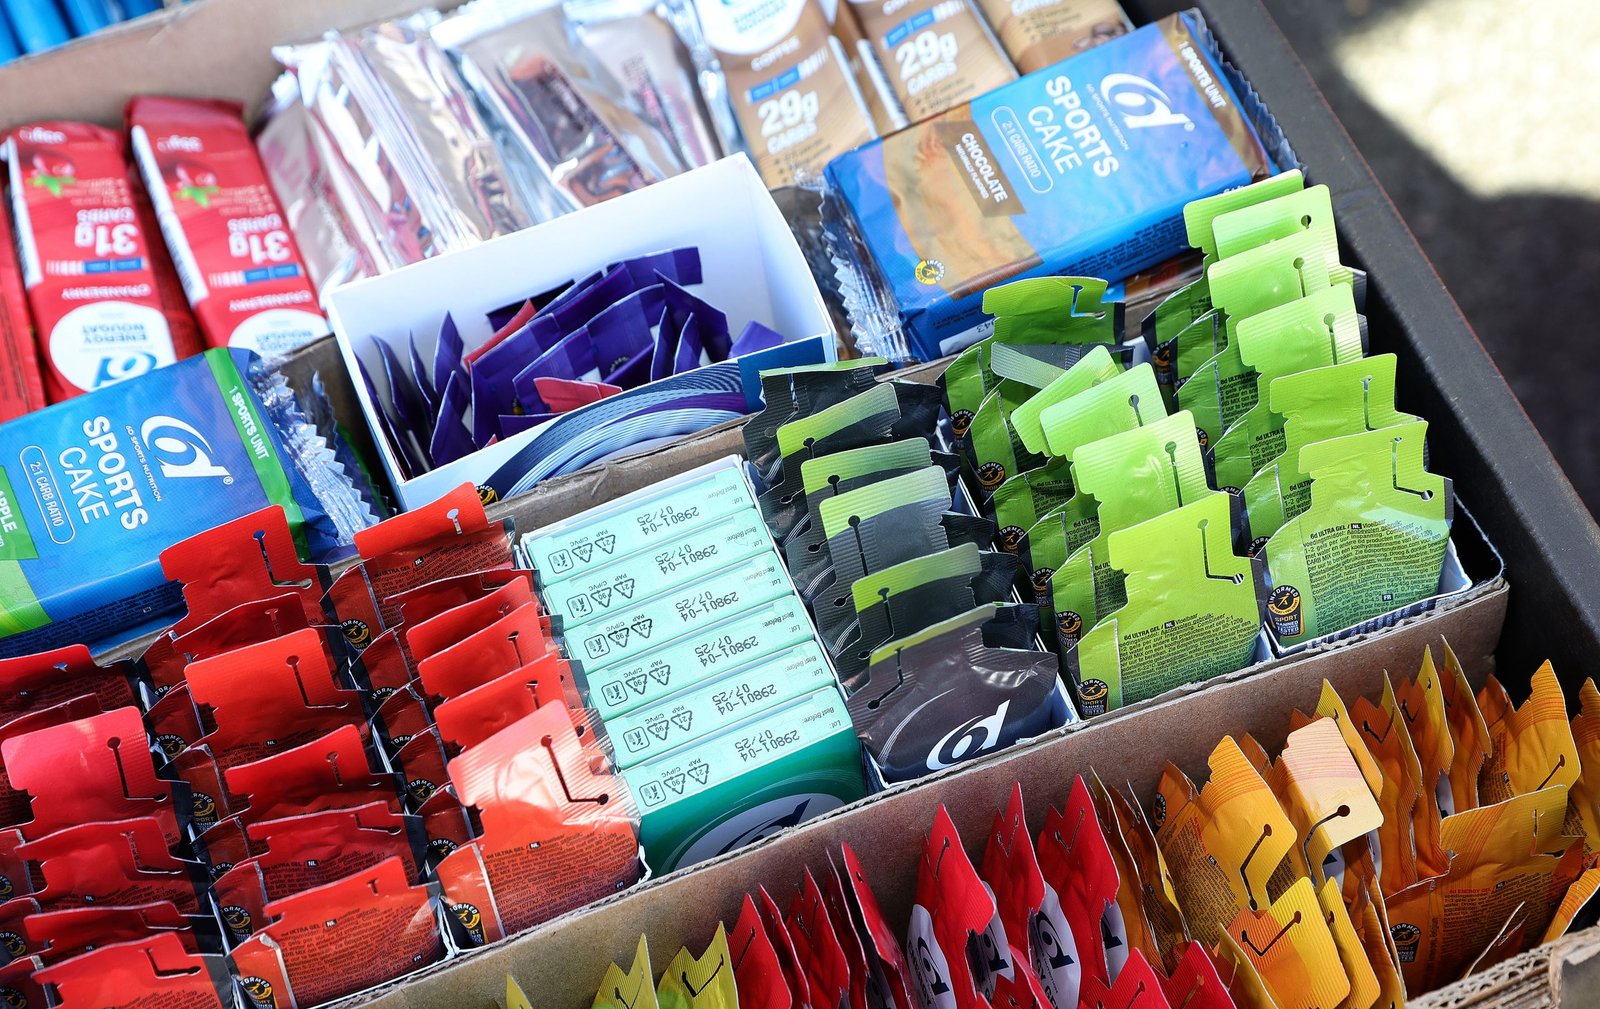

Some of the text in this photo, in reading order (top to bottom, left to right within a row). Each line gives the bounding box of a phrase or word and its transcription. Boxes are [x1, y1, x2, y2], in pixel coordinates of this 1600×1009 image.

[895, 30, 959, 81] 29g
[1180, 44, 1213, 89] SPORTS
[1203, 83, 1226, 110] UNIT
[757, 90, 819, 138] 29g
[1045, 75, 1119, 178] SPORTS
[1001, 119, 1042, 179] 2:1 CARB RATIO
[1026, 106, 1082, 174] CAKE
[960, 132, 1009, 203] CHOCOLATE
[74, 222, 138, 255] 31g
[228, 229, 290, 263] 31g
[61, 283, 150, 299] CRANBERRY
[229, 290, 311, 311] CRANBERRY
[227, 385, 268, 460] 1 SPORTS UNIT
[82, 415, 149, 530] SPORTS
[129, 435, 146, 463] SPORTS
[141, 463, 163, 502] NUTRITION
[28, 460, 64, 527] 2:1 CARB RATIO
[58, 446, 111, 525] CAKE
[637, 506, 673, 526] 07/25
[640, 507, 699, 535] 29801-04
[570, 537, 588, 547] C/PVC
[1318, 527, 1335, 536] ULTRA
[655, 544, 694, 565] 07/25
[658, 539, 762, 574] Lot: 29801-04
[589, 581, 607, 591] C/PVC
[679, 578, 781, 622] Lot: 29801-04
[675, 591, 714, 612] 07/25
[606, 622, 624, 632] C/PVC
[1131, 629, 1149, 638] ULTRA
[1275, 614, 1297, 623] SPORT
[695, 636, 733, 657] 07/25
[698, 636, 758, 666] 29801-04
[624, 660, 662, 678] PAP C/PVC
[712, 684, 750, 705] 07/25
[716, 668, 823, 715] Lot: 29801-04
[645, 713, 664, 724] C/PVC
[735, 730, 774, 752] 07/25
[738, 720, 841, 762] Lot: 29801-04
[662, 758, 701, 778] PAP C/PVC
